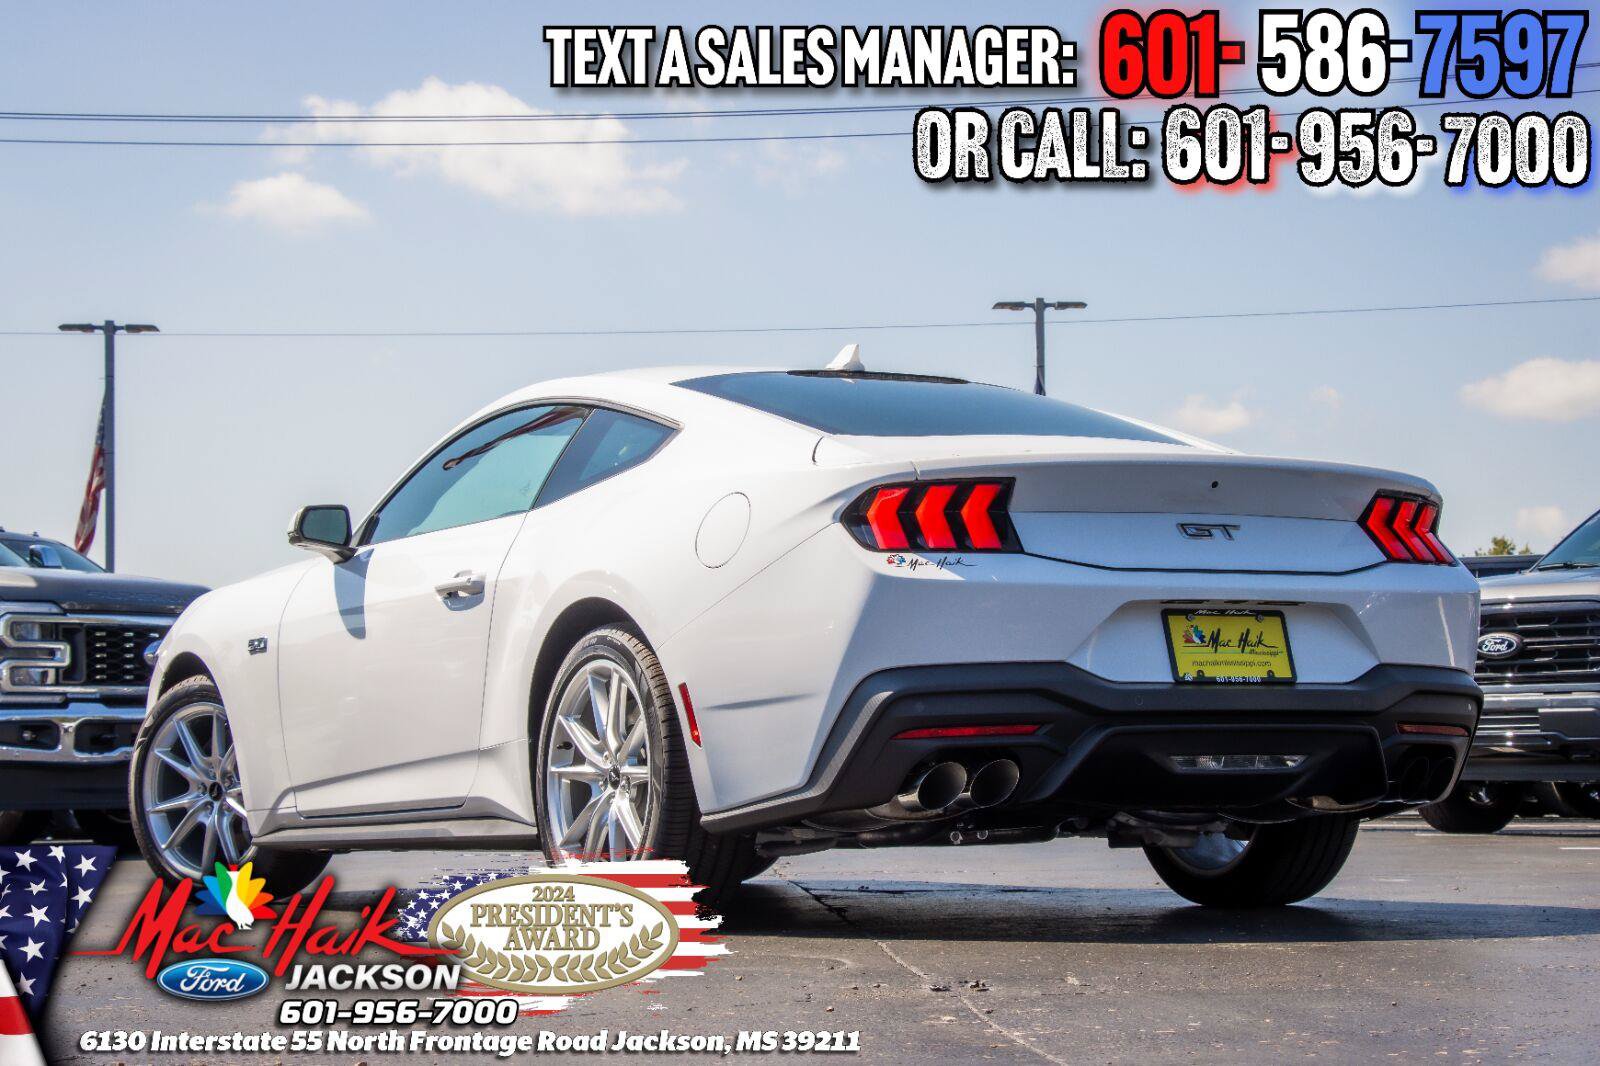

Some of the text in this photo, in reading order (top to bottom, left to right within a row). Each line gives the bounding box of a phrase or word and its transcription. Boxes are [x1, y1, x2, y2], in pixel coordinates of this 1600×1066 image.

[1176, 523, 1240, 541] GT
[907, 556, 978, 571] Mac Haik
[1207, 628, 1278, 654] Mac Haik
[1481, 639, 1508, 652] Ford
